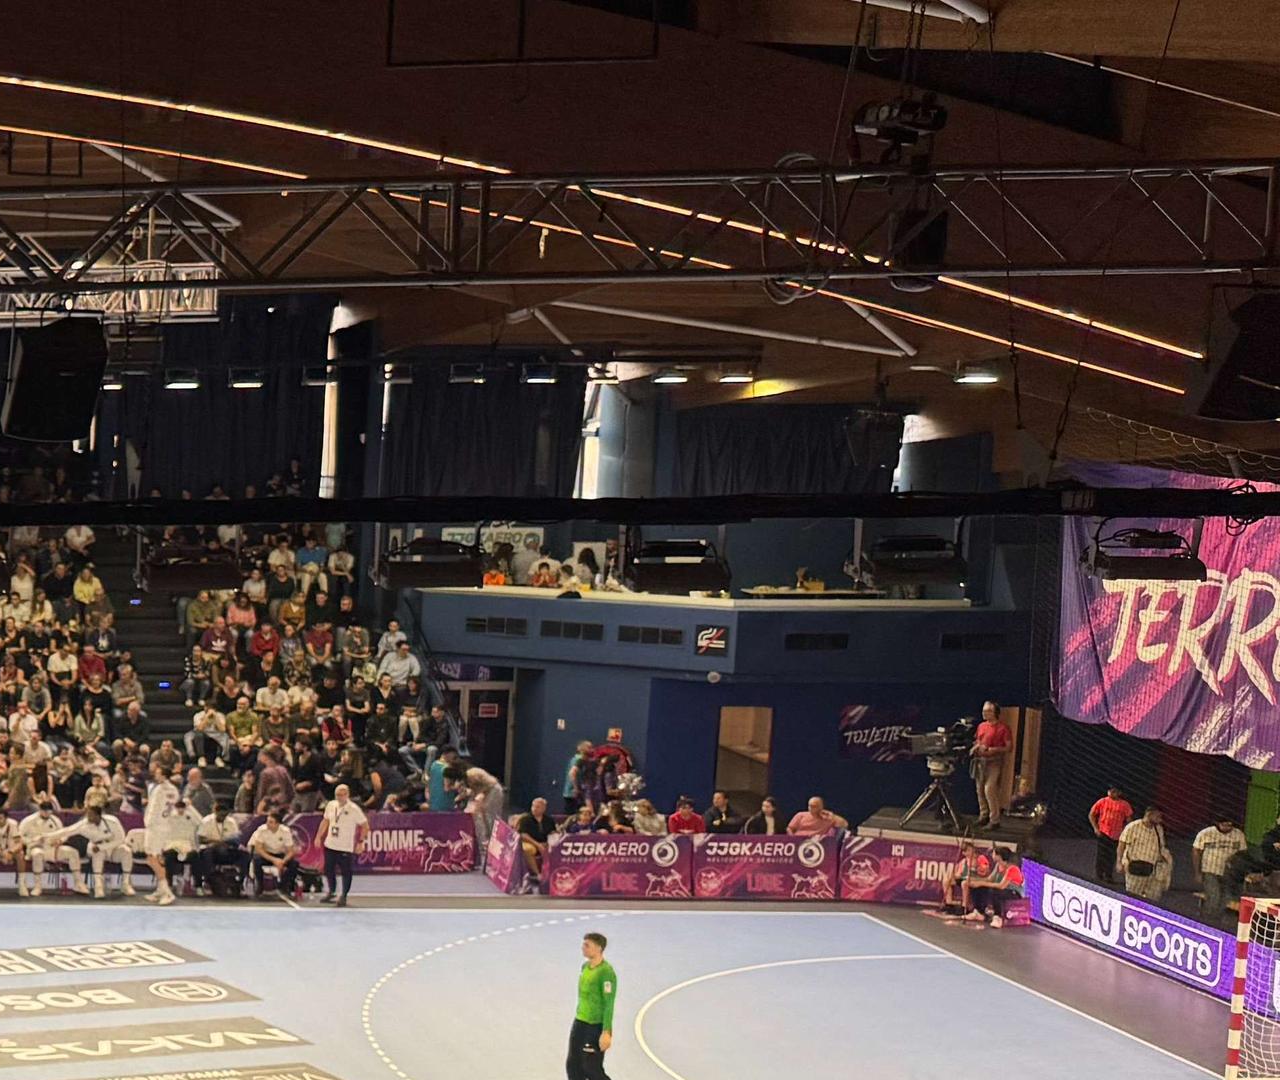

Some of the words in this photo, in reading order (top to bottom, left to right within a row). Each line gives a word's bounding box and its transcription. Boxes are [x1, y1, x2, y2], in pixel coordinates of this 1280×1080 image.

[1102, 568, 1280, 706] TERR
[365, 829, 424, 851] HOMME
[892, 845, 904, 856] ICI
[915, 860, 954, 880] HOM
[1050, 879, 1112, 937] beIN
[1123, 914, 1212, 976] SPORTS
